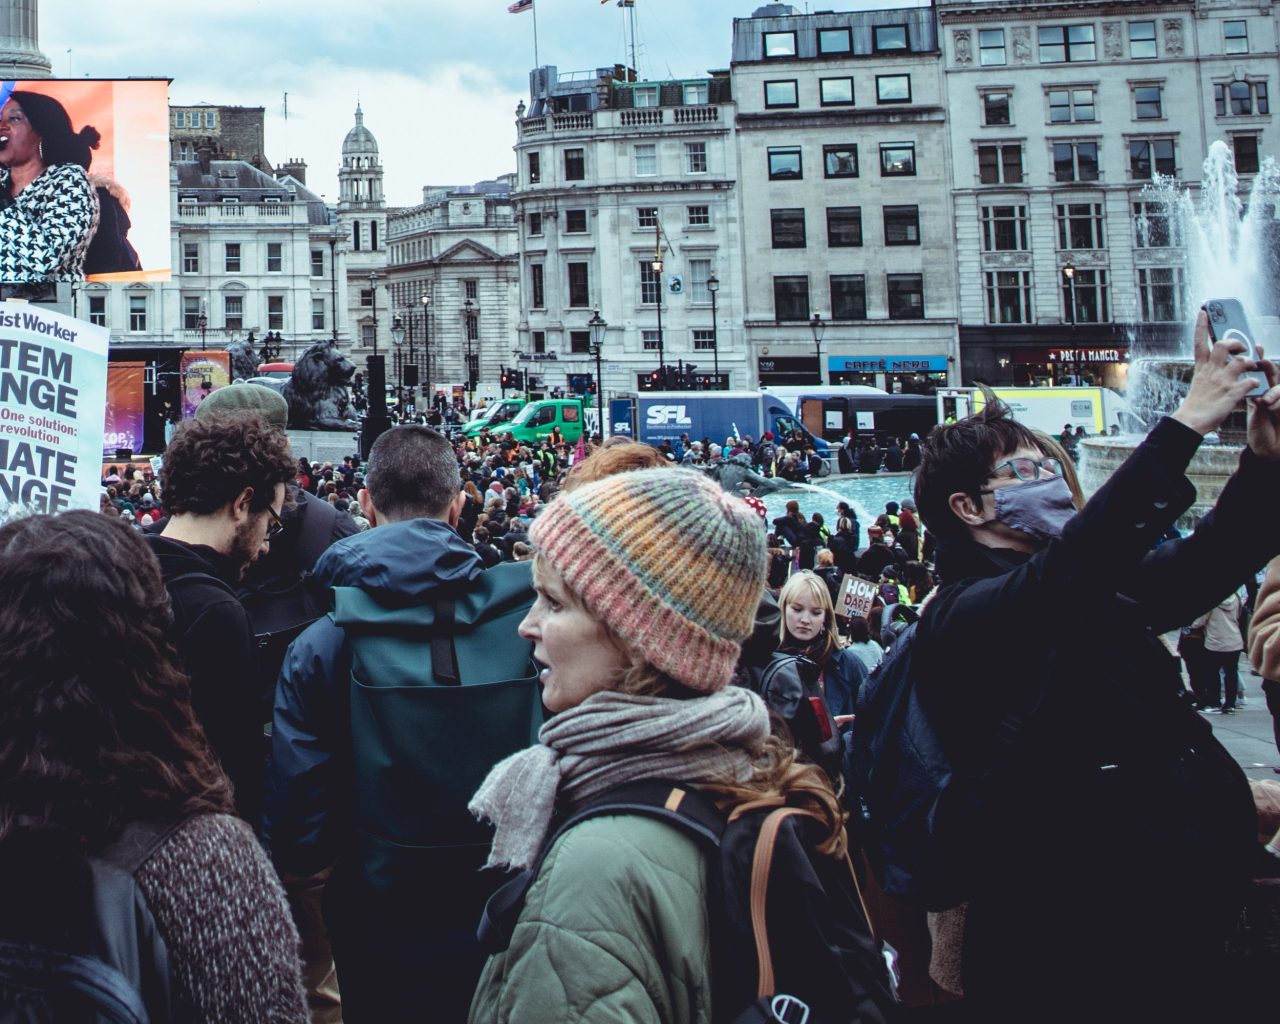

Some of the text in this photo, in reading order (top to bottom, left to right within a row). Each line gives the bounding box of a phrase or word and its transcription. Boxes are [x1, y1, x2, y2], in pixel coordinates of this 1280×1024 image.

[23, 312, 78, 343] Worker
[892, 360, 930, 369] NERO
[1080, 350, 1086, 361] A
[1088, 349, 1120, 361] MANGER
[0, 408, 78, 437] One solution:
[646, 405, 692, 424] SFL
[0, 424, 60, 445] revolution
[614, 422, 631, 432] SFL
[121, 439, 135, 449] 26
[846, 578, 876, 601] HOW
[844, 593, 870, 613] DARE
